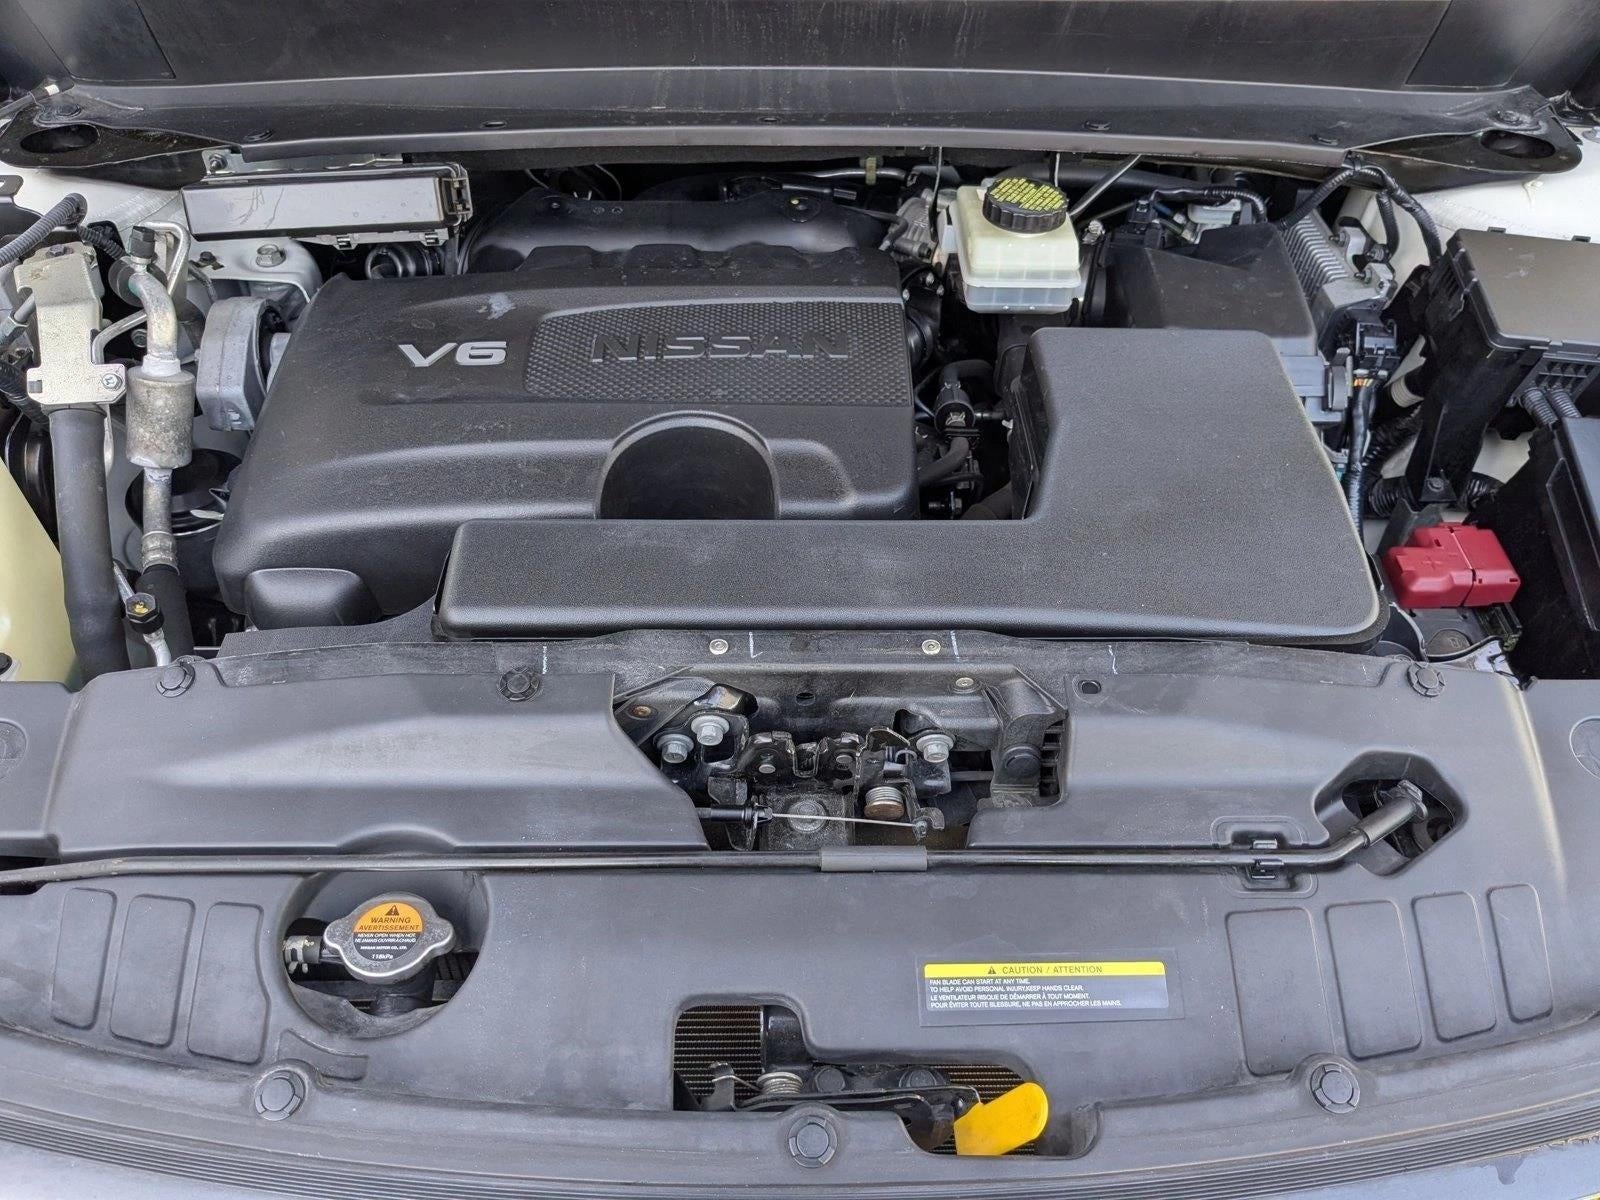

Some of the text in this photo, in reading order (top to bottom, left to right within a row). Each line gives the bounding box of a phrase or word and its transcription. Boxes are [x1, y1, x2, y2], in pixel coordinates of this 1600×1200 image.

[397, 341, 508, 370] V6
[590, 331, 849, 364] NISSAN
[1002, 966, 1042, 974] CAUTION
[1053, 964, 1103, 974] ATTENTION
[1042, 992, 1047, 1000] À
